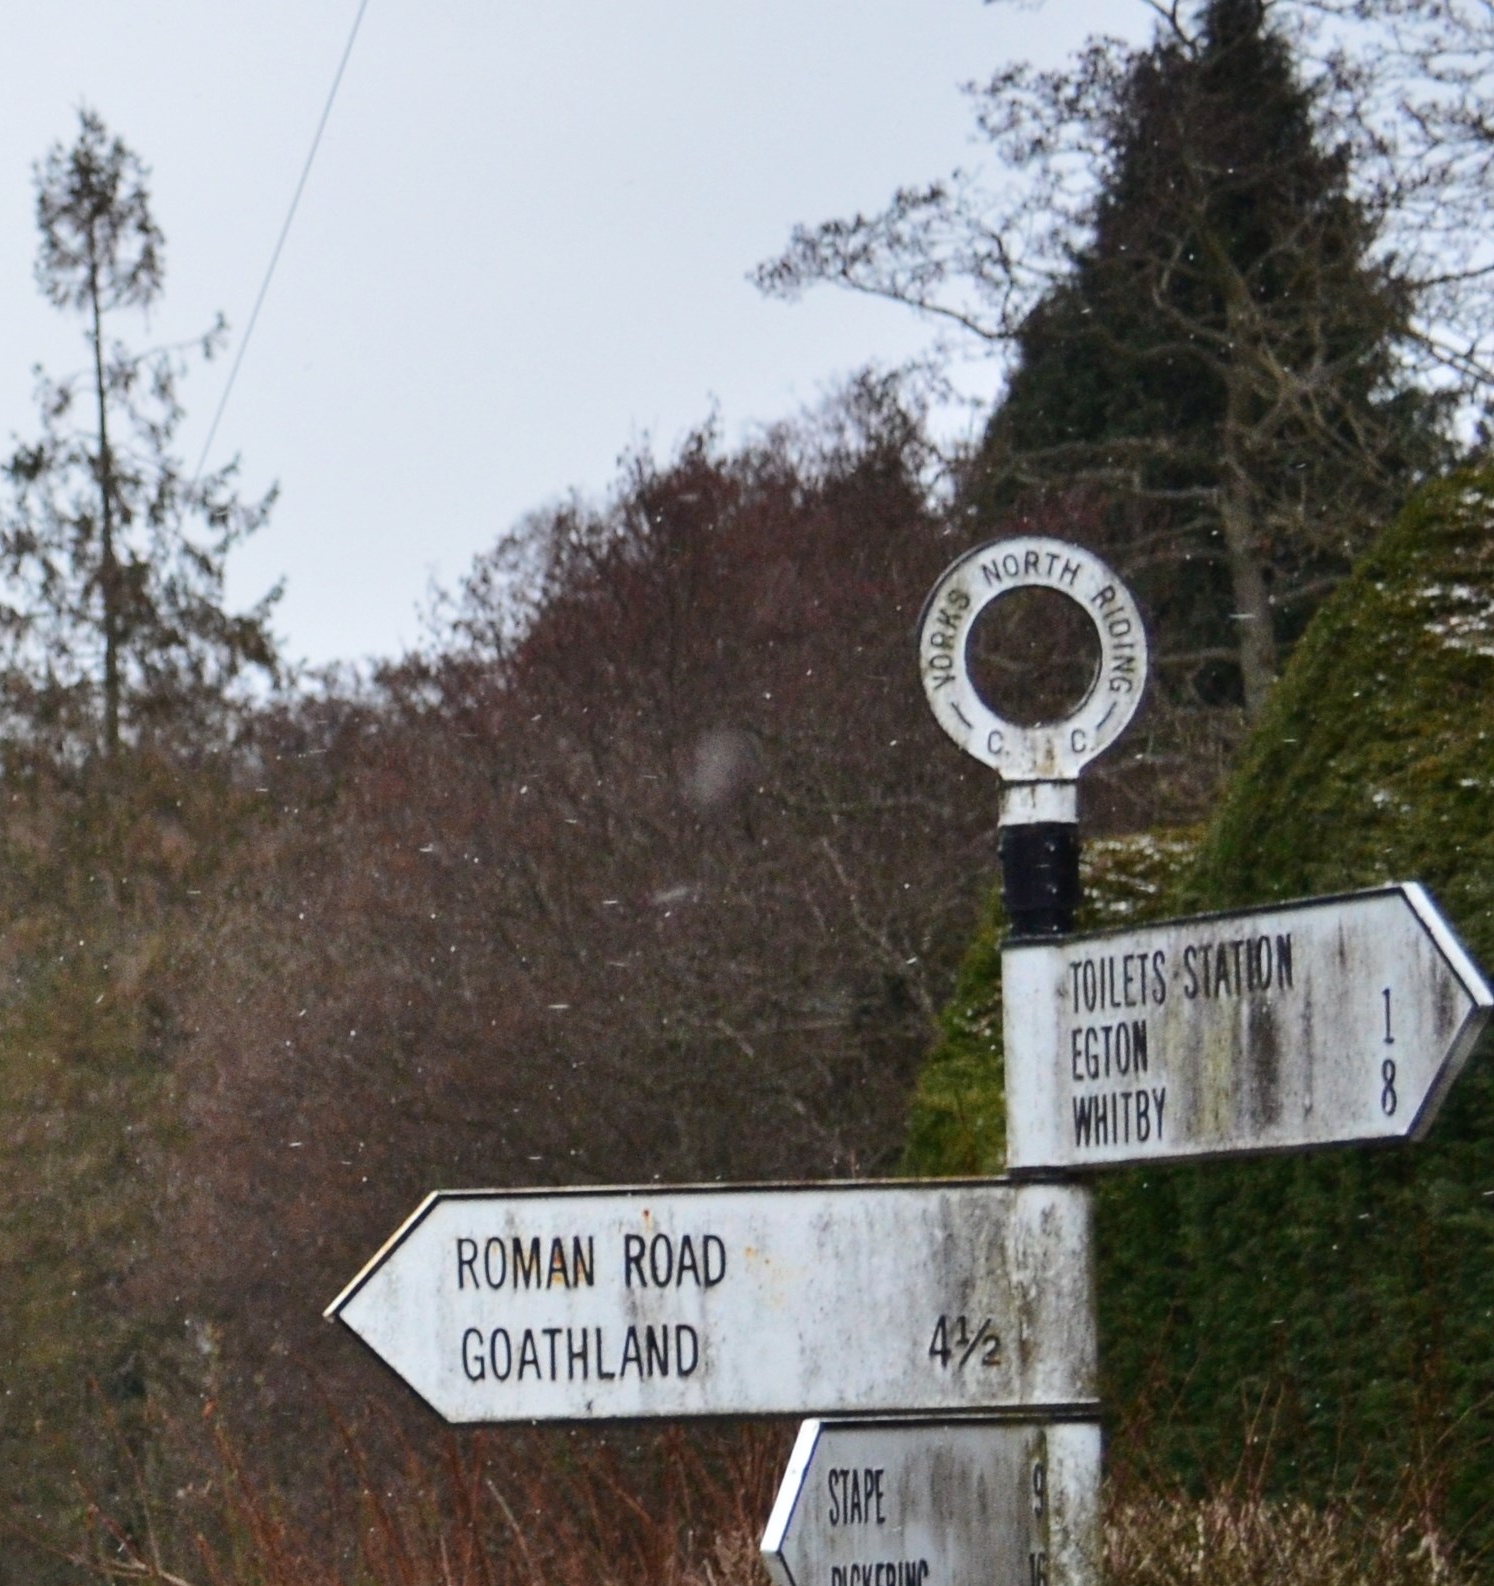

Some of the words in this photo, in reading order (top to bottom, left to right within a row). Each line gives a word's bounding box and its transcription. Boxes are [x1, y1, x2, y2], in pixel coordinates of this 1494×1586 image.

[928, 588, 971, 690] YORKS
[980, 550, 1082, 586] NORTH
[1090, 584, 1135, 694] RIDING
[987, 730, 1004, 754] C
[1070, 728, 1087, 753] C
[1069, 950, 1167, 1014] TOILETS
[1183, 932, 1294, 999] STATION
[1071, 1019, 1148, 1082] EGTON
[1380, 988, 1396, 1043] 1
[1072, 1087, 1166, 1148] WHITBY
[1380, 1059, 1398, 1117] 8
[456, 1234, 595, 1291] ROMAN
[623, 1232, 728, 1288] ROAD
[461, 1322, 701, 1382] GOATHLAND
[828, 1468, 886, 1527] STAPE
[1032, 1462, 1044, 1519] 9
